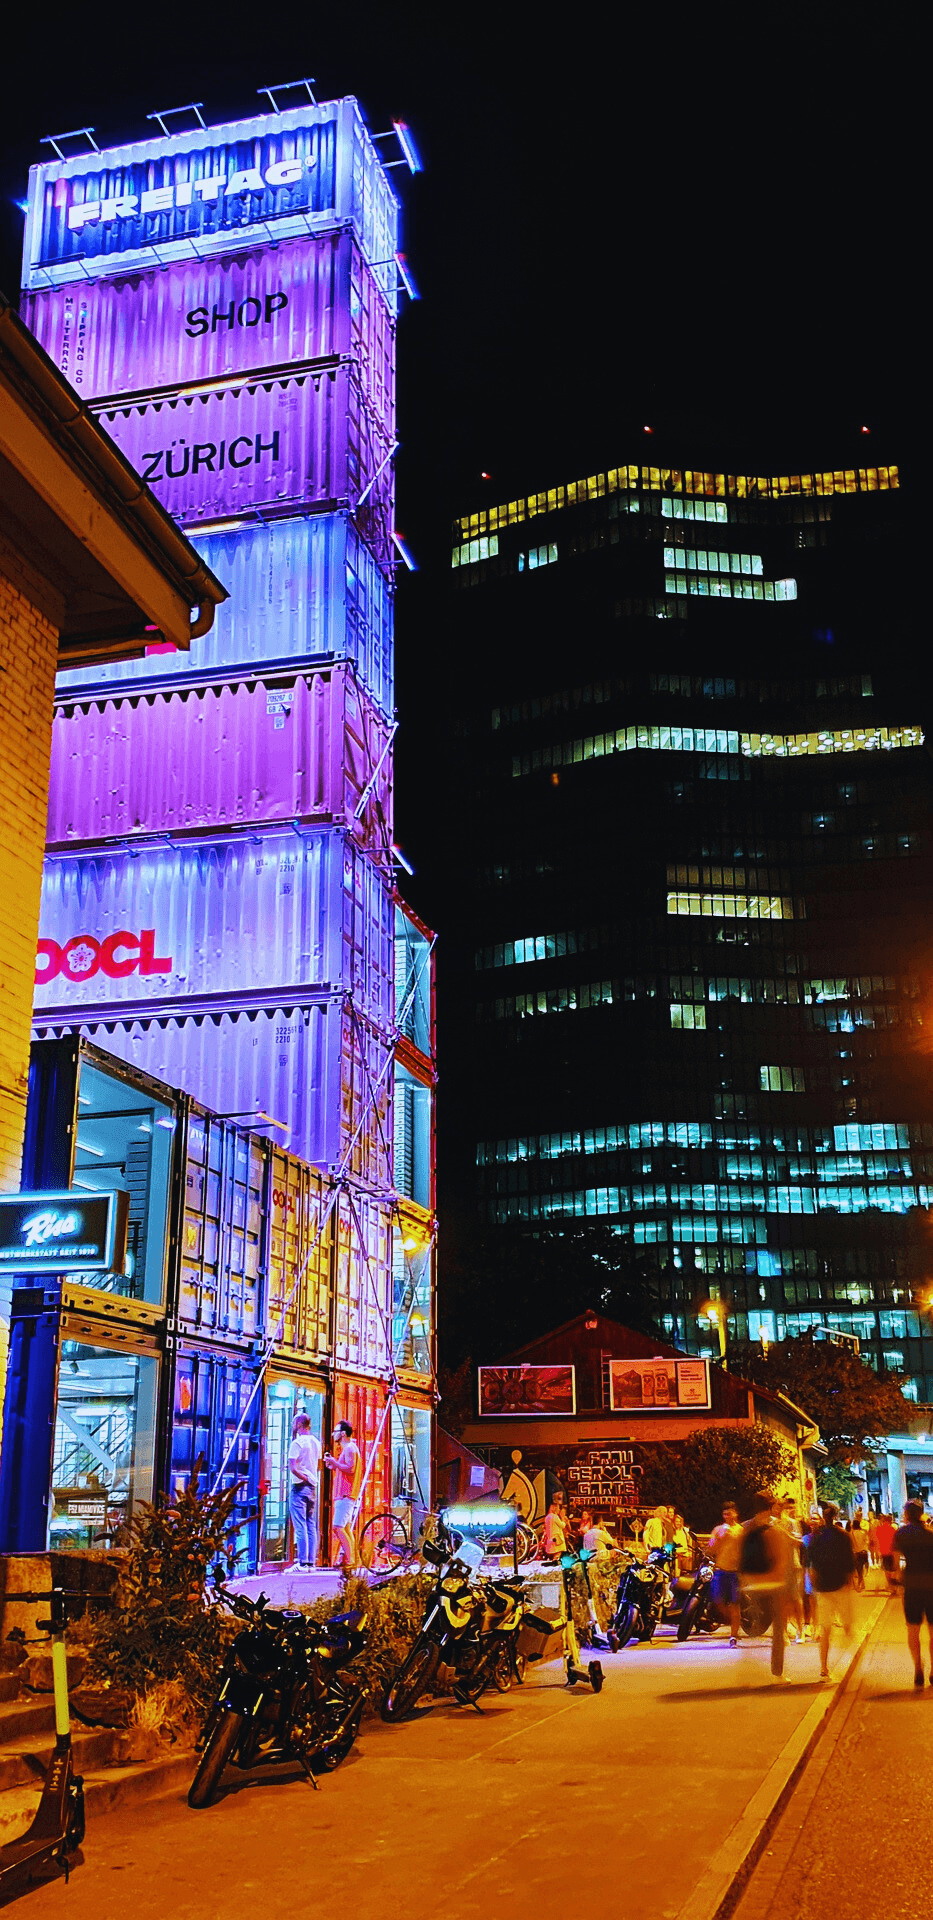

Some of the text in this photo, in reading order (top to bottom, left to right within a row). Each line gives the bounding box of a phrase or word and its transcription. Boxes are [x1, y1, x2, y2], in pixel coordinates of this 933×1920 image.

[67, 158, 303, 230] FREITAG
[185, 291, 288, 338] SHOP
[75, 302, 87, 384] SIPPING CO
[141, 430, 280, 483] ZÜRICH
[34, 928, 173, 986] OOCL
[275, 1035, 291, 1044] 2210
[588, 1450, 634, 1465] FRAU
[578, 1480, 639, 1495] GARTE
